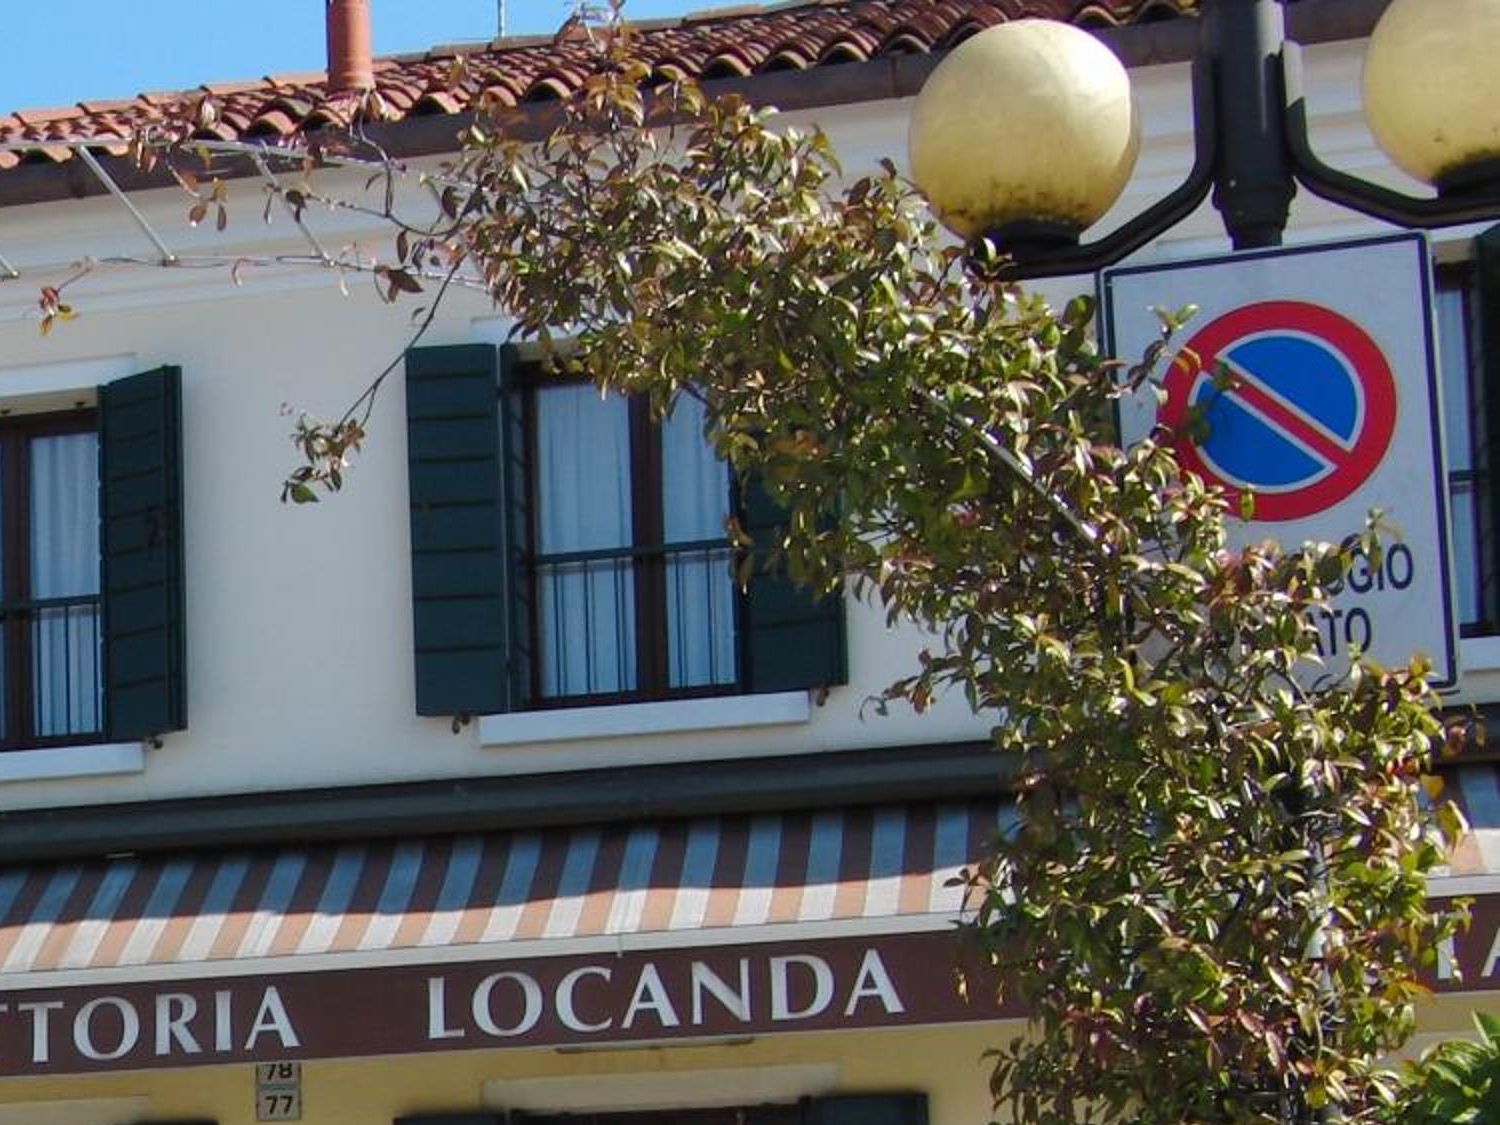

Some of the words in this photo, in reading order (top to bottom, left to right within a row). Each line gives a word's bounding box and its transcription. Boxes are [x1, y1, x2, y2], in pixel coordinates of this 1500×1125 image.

[426, 947, 905, 1040] LOCANDA
[265, 1062, 293, 1081] 78
[264, 1095, 293, 1115] 77
